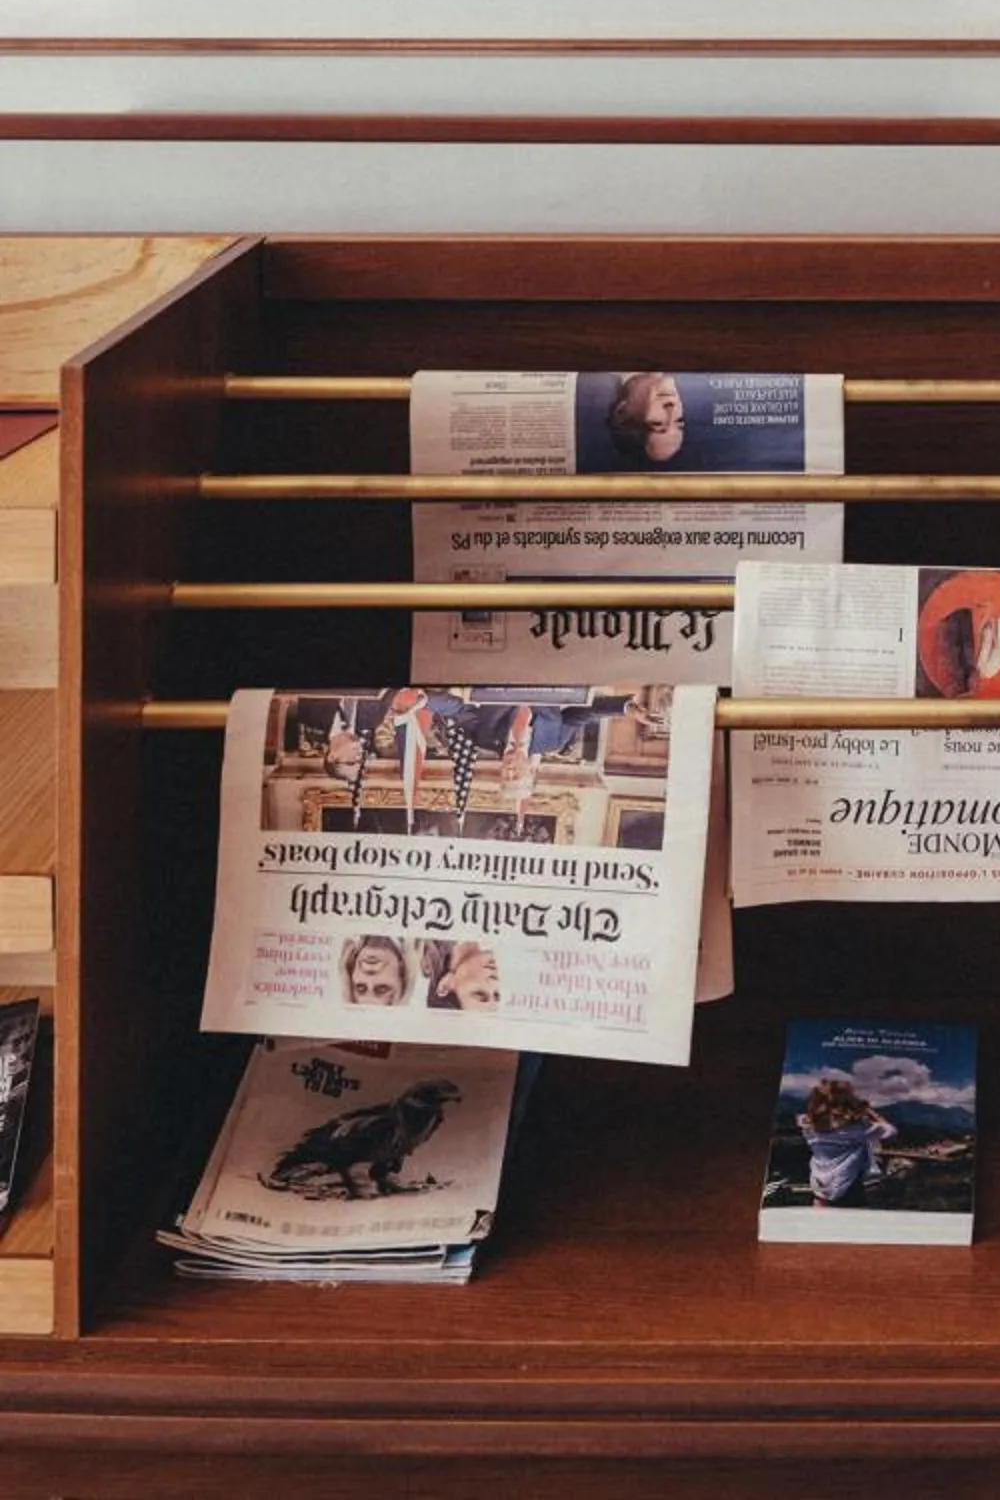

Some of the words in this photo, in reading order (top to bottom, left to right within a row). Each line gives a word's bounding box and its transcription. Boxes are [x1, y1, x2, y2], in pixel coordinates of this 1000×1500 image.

[450, 532, 470, 550] PS
[474, 532, 493, 551] du
[496, 532, 510, 548] et
[512, 528, 580, 550] syndicats
[584, 532, 609, 550] des
[612, 527, 682, 549] exigences
[685, 532, 711, 546] aux
[714, 532, 744, 550] face
[746, 531, 805, 550] Lecornu
[528, 612, 675, 654] Monde
[680, 612, 722, 652] Le
[753, 732, 828, 752] pro-Israël
[832, 734, 875, 756] lobby
[880, 740, 899, 757] Le
[944, 742, 982, 753] nous
[344, 840, 400, 868] stop
[406, 849, 432, 871] to
[438, 845, 543, 882] military
[552, 859, 576, 885] in
[856, 869, 904, 878] CUBAINE
[910, 869, 986, 879] L'OPPOSITION
[290, 883, 453, 932] Telegraph
[460, 892, 551, 937] Daily
[557, 901, 621, 943] The
[256, 947, 330, 964] everything
[540, 949, 607, 972] Netflix
[538, 972, 591, 992] taken
[506, 994, 568, 1012] writer
[572, 999, 643, 1024] Thriller
